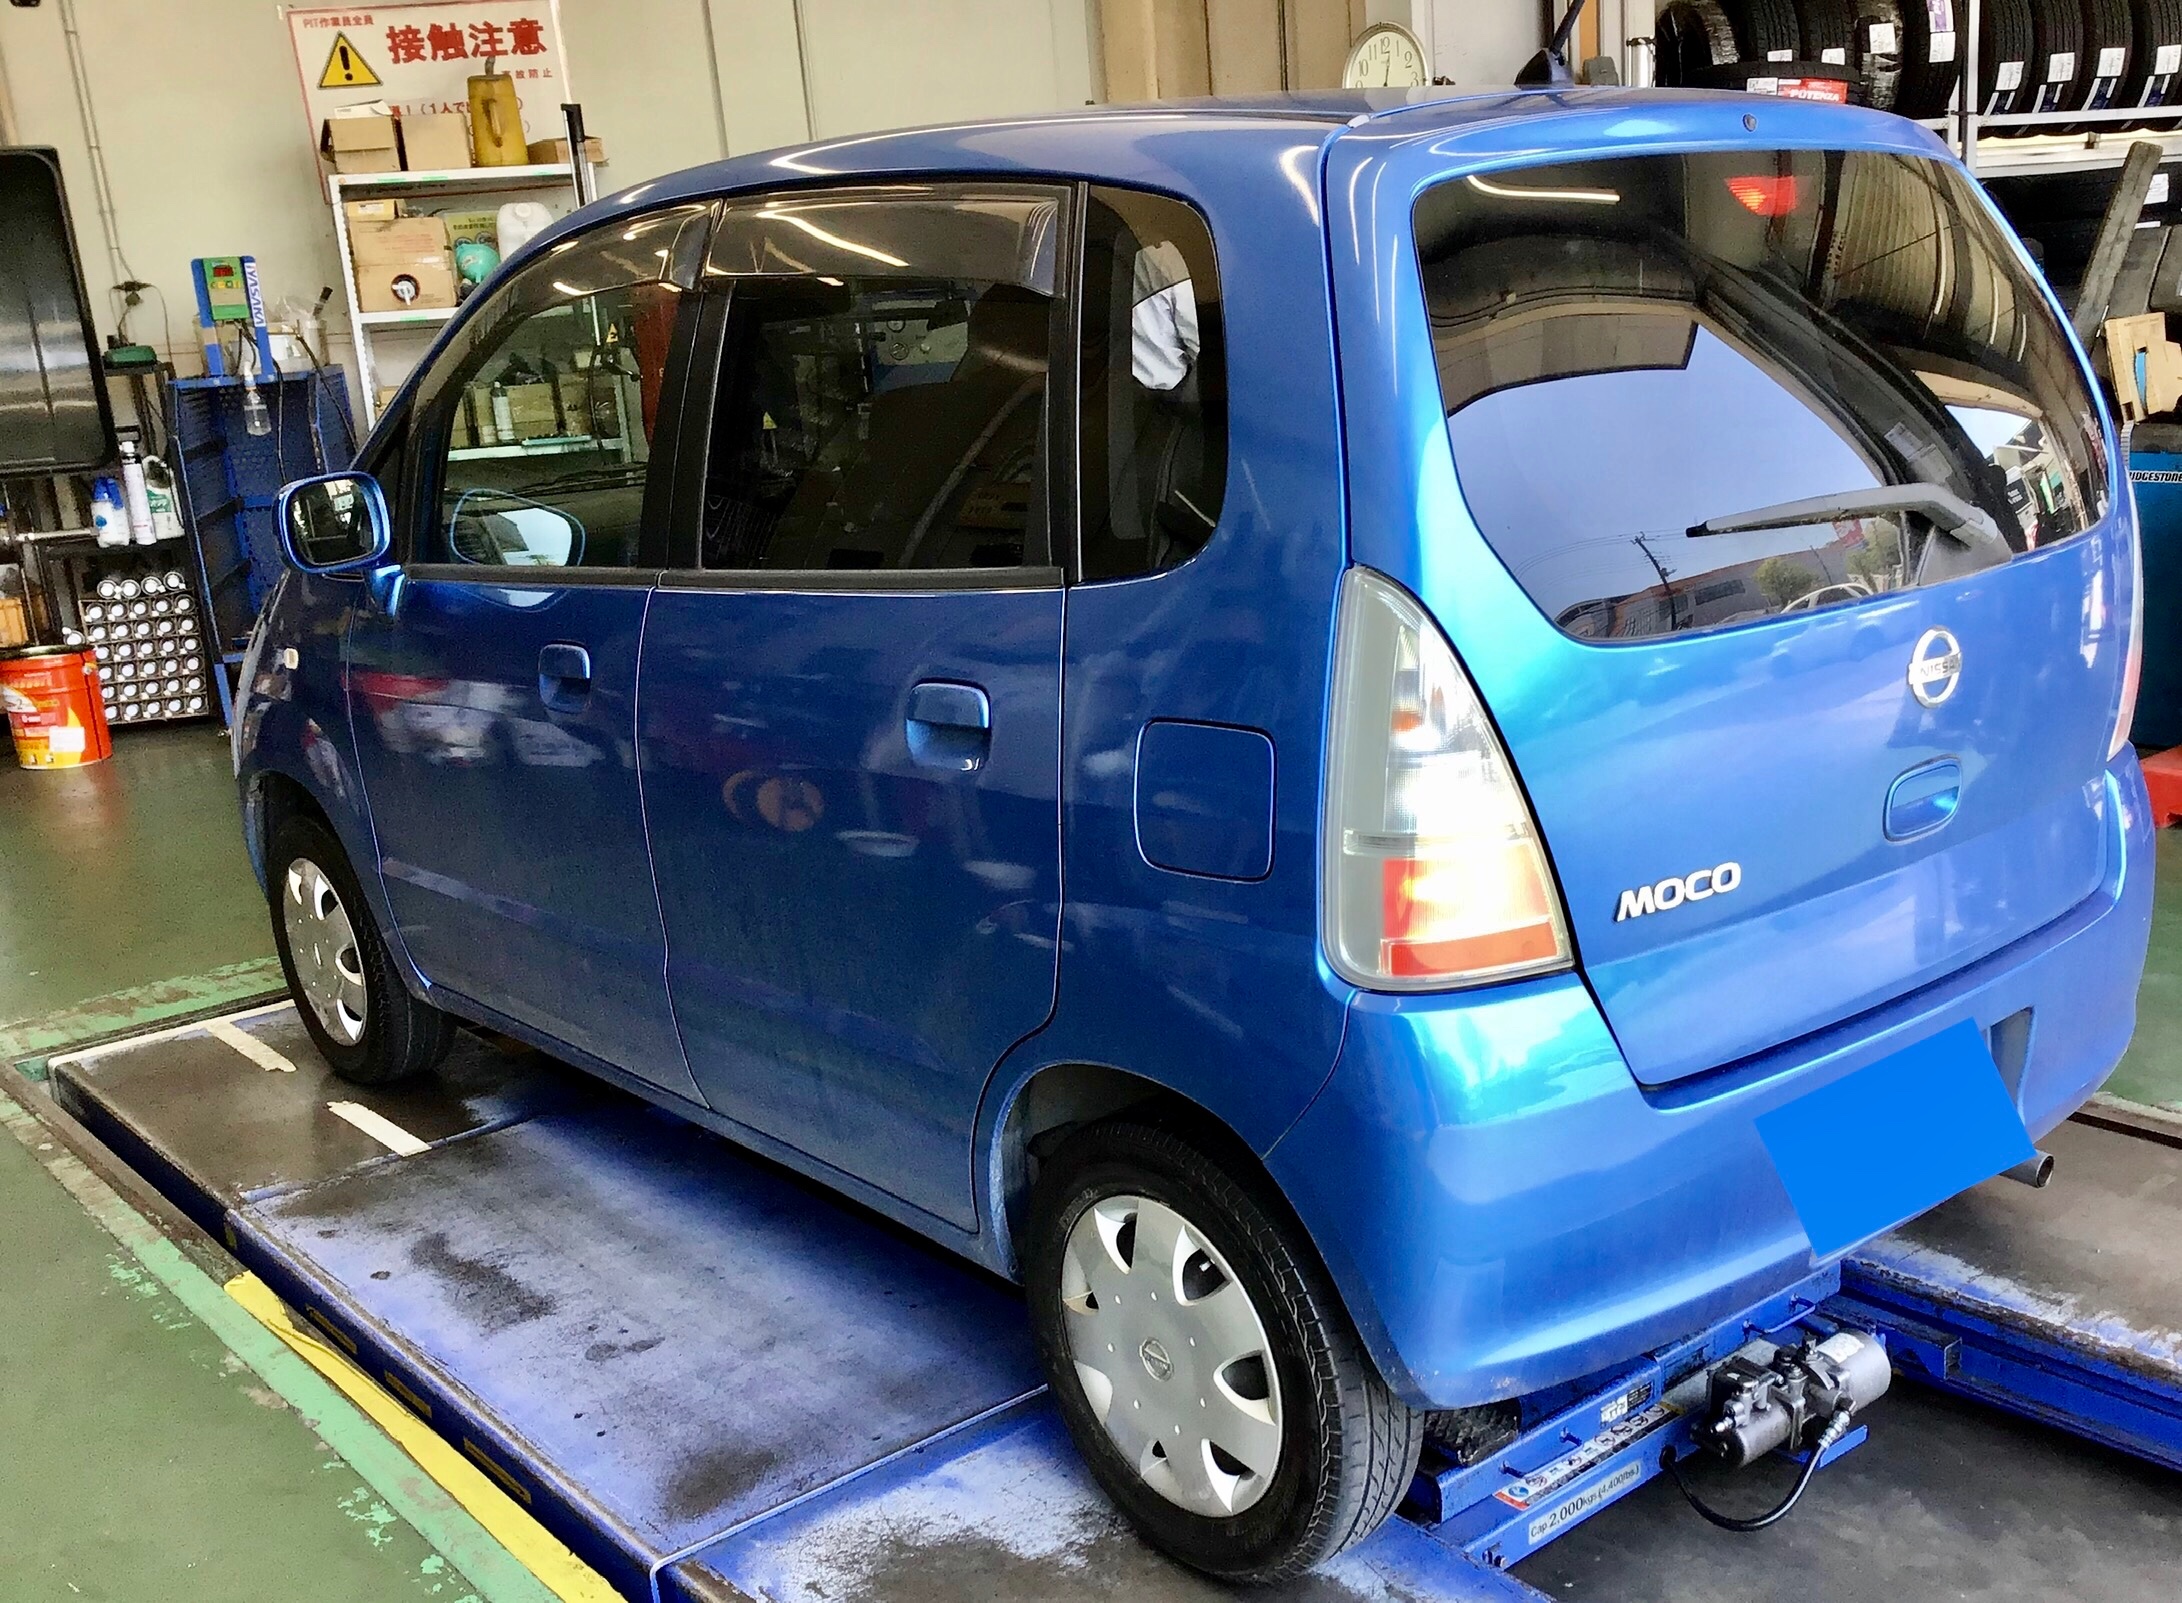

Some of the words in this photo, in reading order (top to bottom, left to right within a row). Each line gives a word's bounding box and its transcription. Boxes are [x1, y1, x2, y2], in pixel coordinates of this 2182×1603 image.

[386, 18, 547, 64] 接触注意
[1789, 88, 1840, 102] POTENZA
[1614, 862, 1741, 922] MOCO
